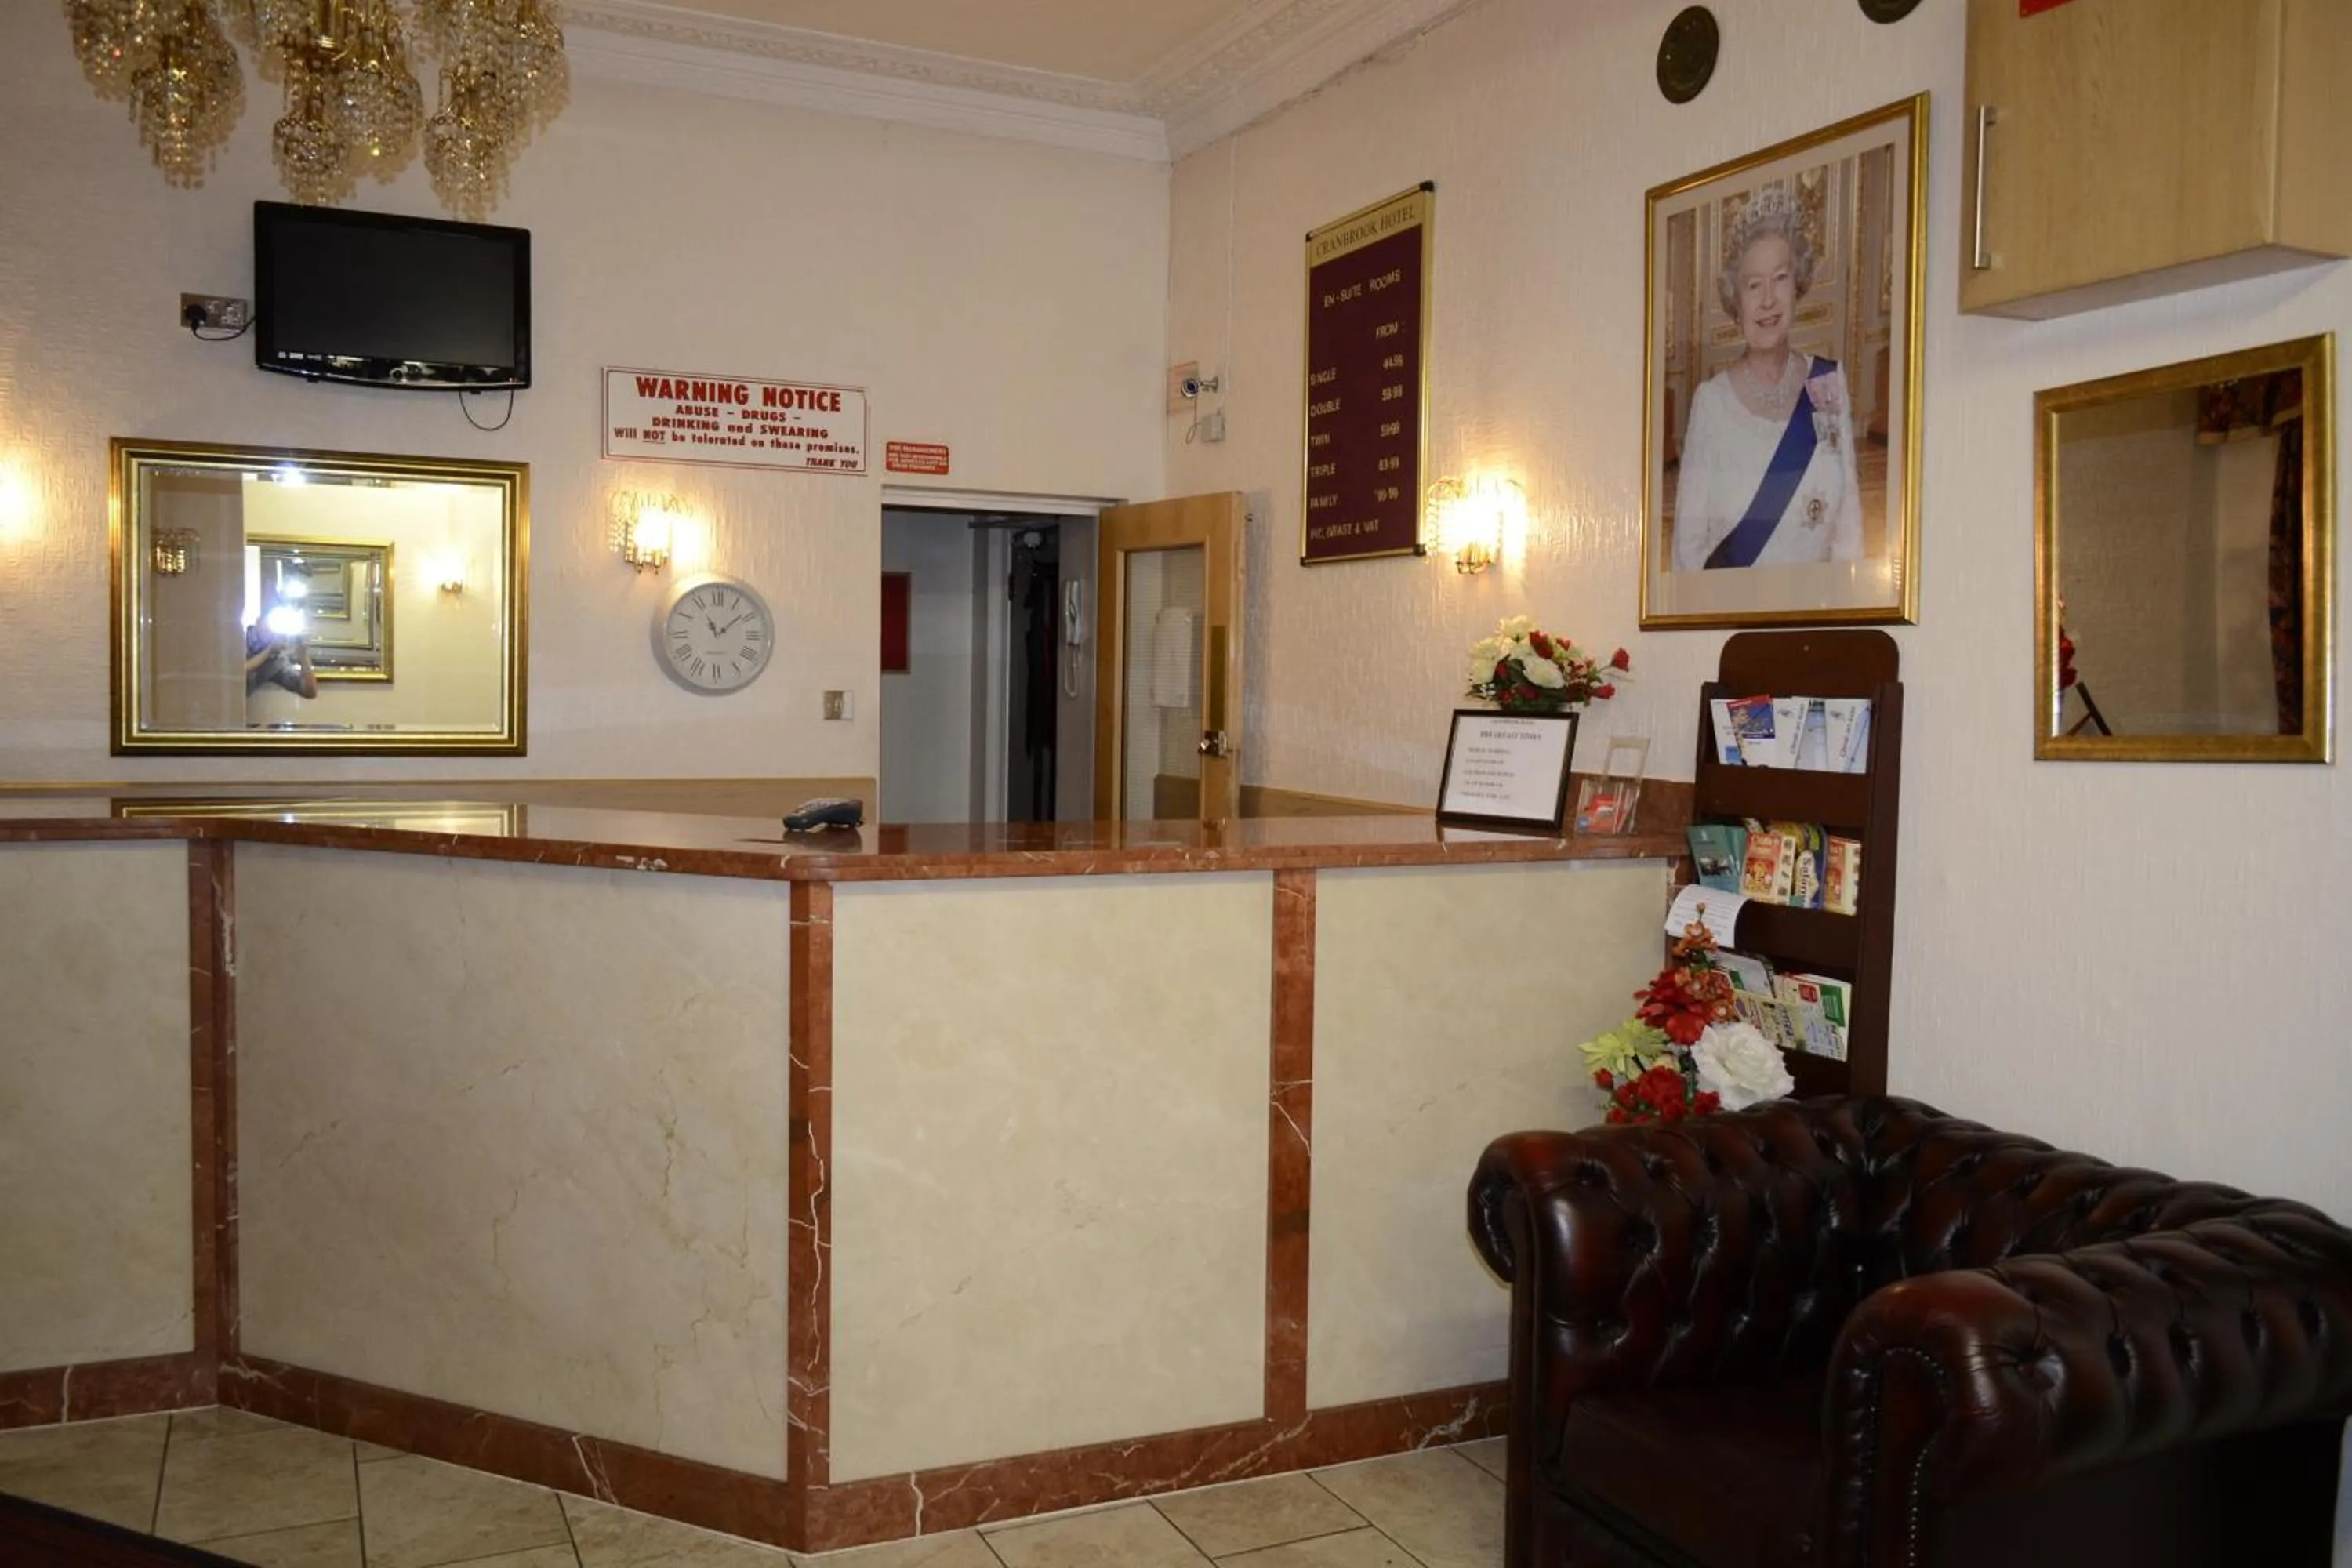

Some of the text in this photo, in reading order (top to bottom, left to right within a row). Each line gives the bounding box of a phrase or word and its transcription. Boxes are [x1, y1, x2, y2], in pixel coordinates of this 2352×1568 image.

[1381, 205, 1415, 230] HOTEL
[1370, 269, 1401, 293] ROOMS
[1376, 321, 1399, 339] FROM
[636, 376, 841, 412] WARNING NOTICE
[676, 405, 719, 417] ABUSE
[742, 409, 787, 422] DRUGS
[614, 427, 637, 439] Will
[643, 430, 666, 441] NOT
[672, 431, 686, 441] be
[692, 433, 746, 446] tolerated
[751, 439, 764, 448] on
[771, 438, 800, 450] these
[652, 416, 829, 439] DRINKING and SWEARING
[806, 457, 858, 469] THANK YOU
